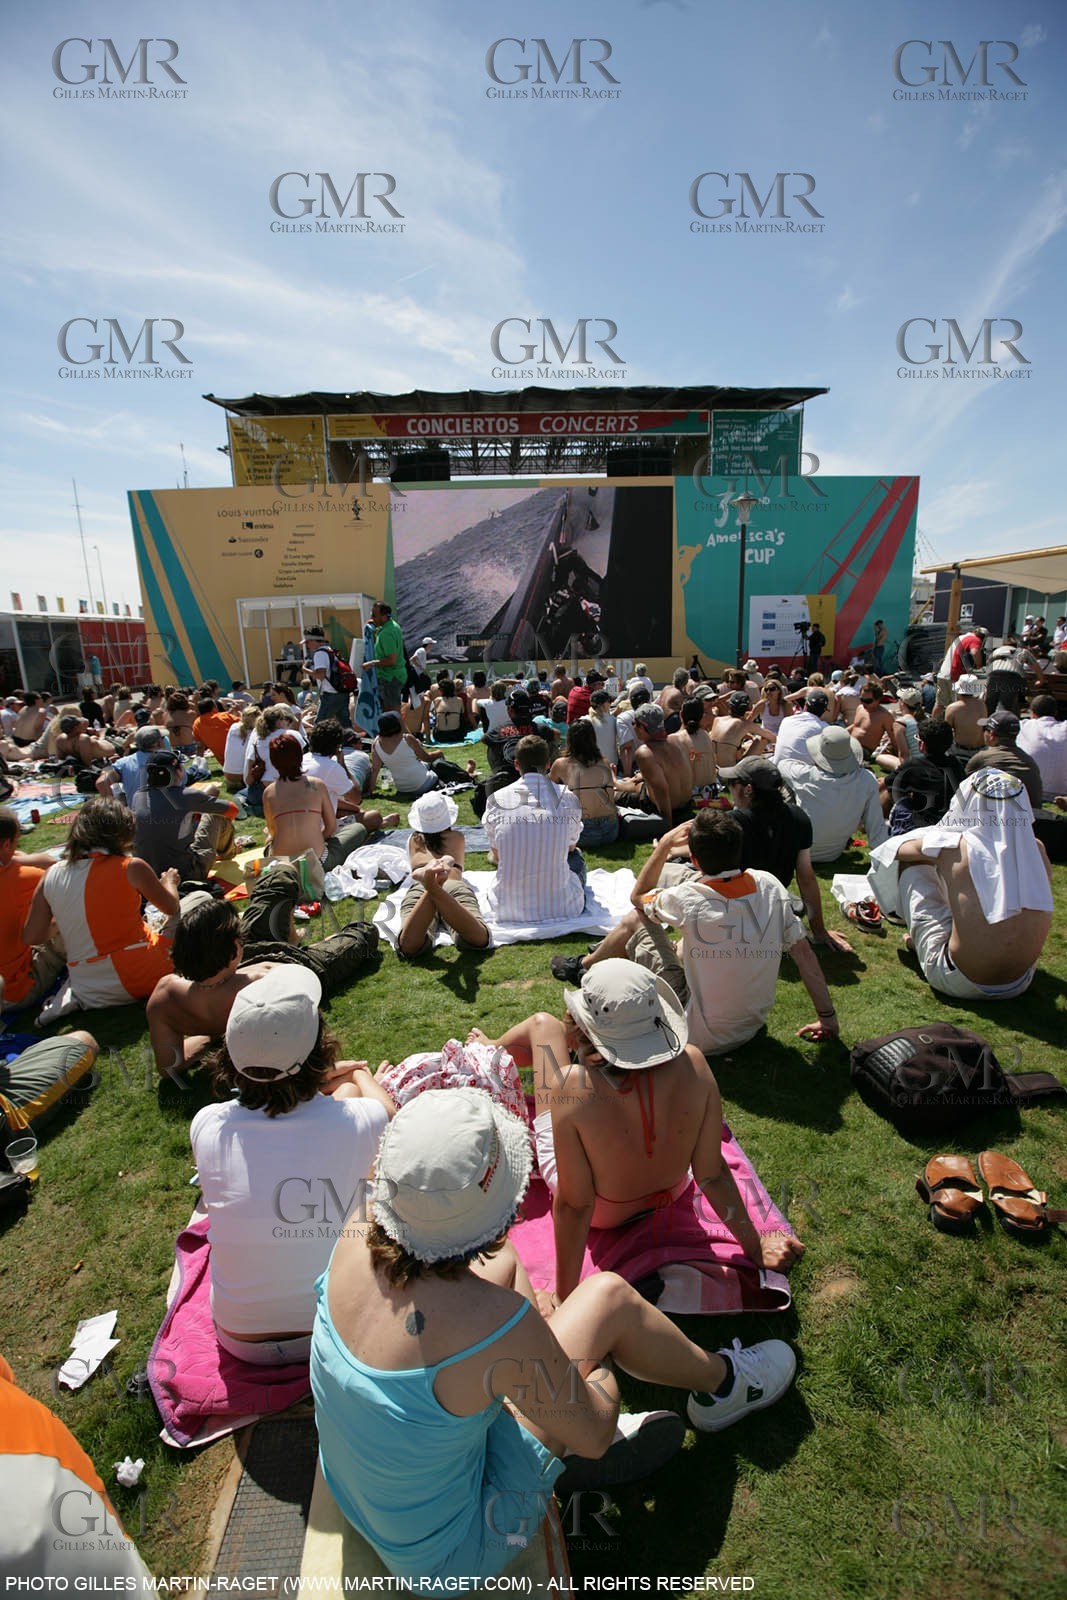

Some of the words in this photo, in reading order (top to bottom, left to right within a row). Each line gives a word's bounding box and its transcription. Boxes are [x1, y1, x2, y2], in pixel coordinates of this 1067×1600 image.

[406, 416, 520, 434] CONCIERTOS
[539, 416, 639, 433] CONCERTS
[217, 510, 241, 518] LOUIS
[243, 508, 280, 516] VUITTON
[744, 548, 776, 565] CUP
